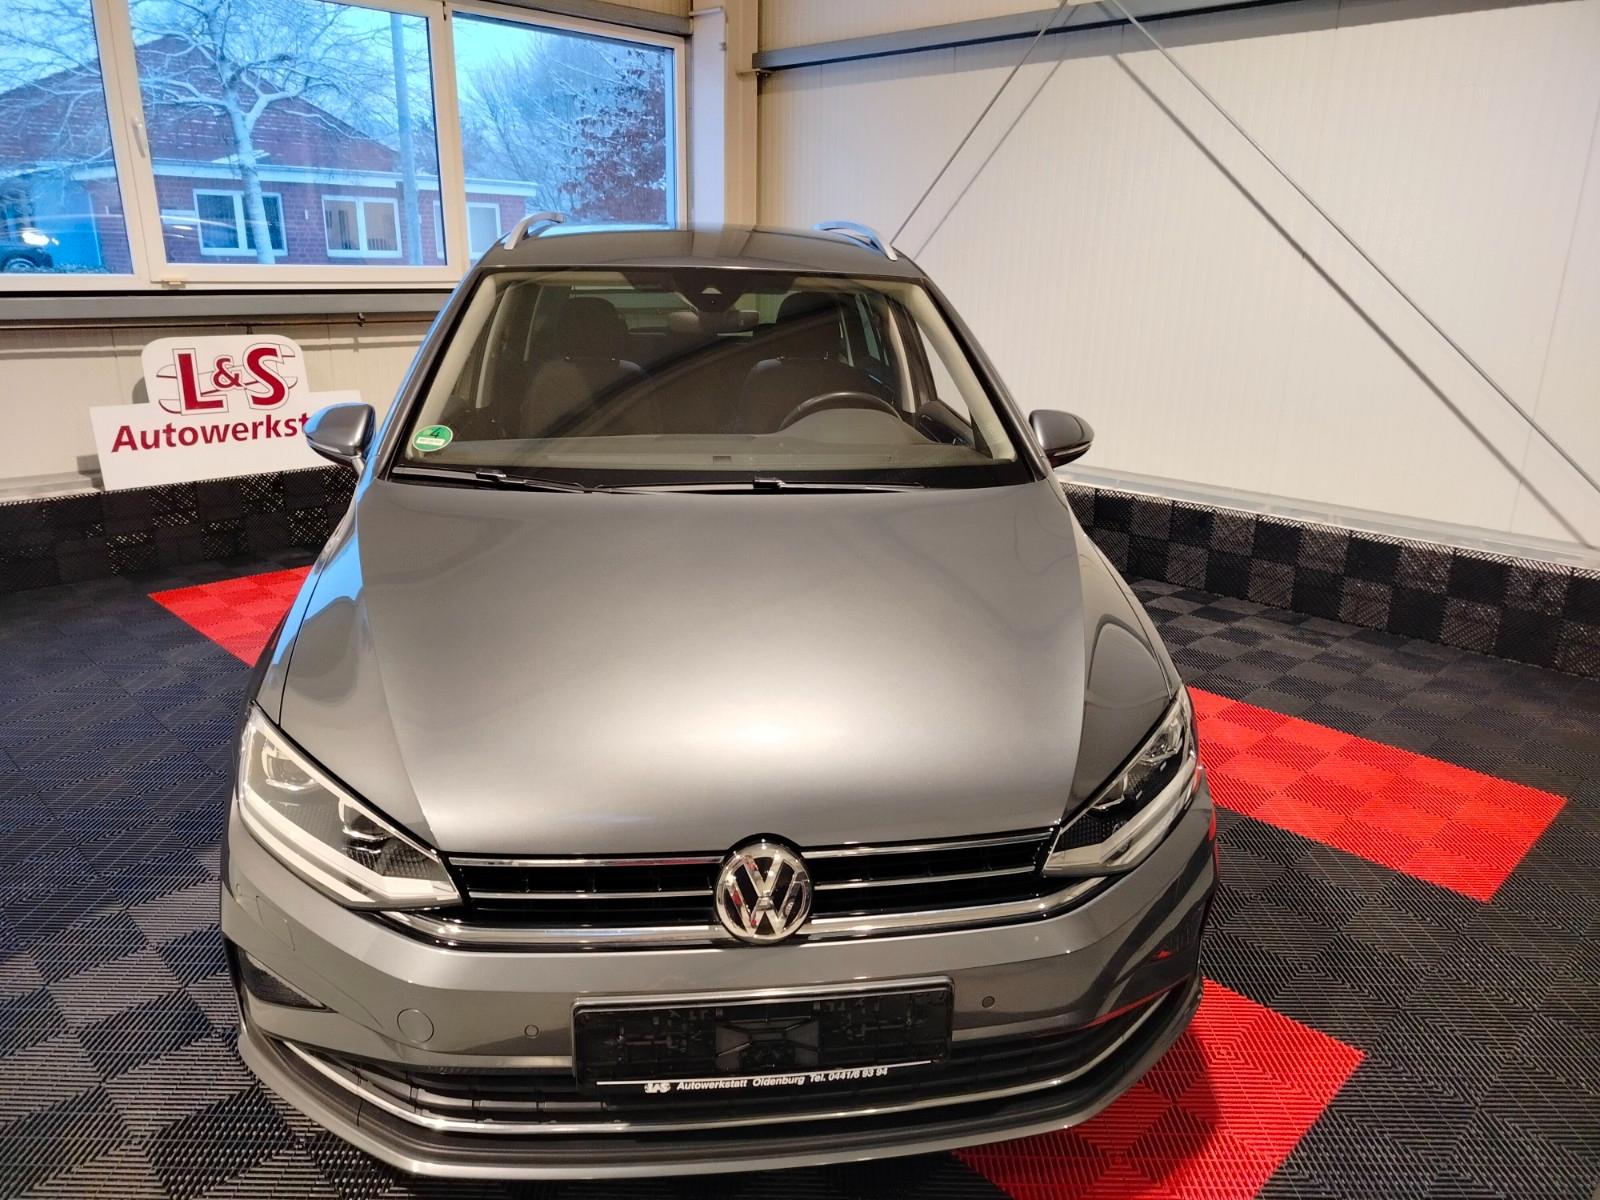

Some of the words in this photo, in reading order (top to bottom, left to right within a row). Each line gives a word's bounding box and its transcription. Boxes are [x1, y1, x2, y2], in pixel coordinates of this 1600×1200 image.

[173, 344, 288, 414] L&S
[430, 427, 442, 438] 4
[716, 842, 811, 943] VW
[677, 1080, 747, 1091] Autowerkstatt
[752, 1077, 805, 1087] Oldenburg
[810, 1074, 826, 1083] Tel.
[862, 1068, 874, 1078] 93
[876, 1067, 888, 1076] 94
